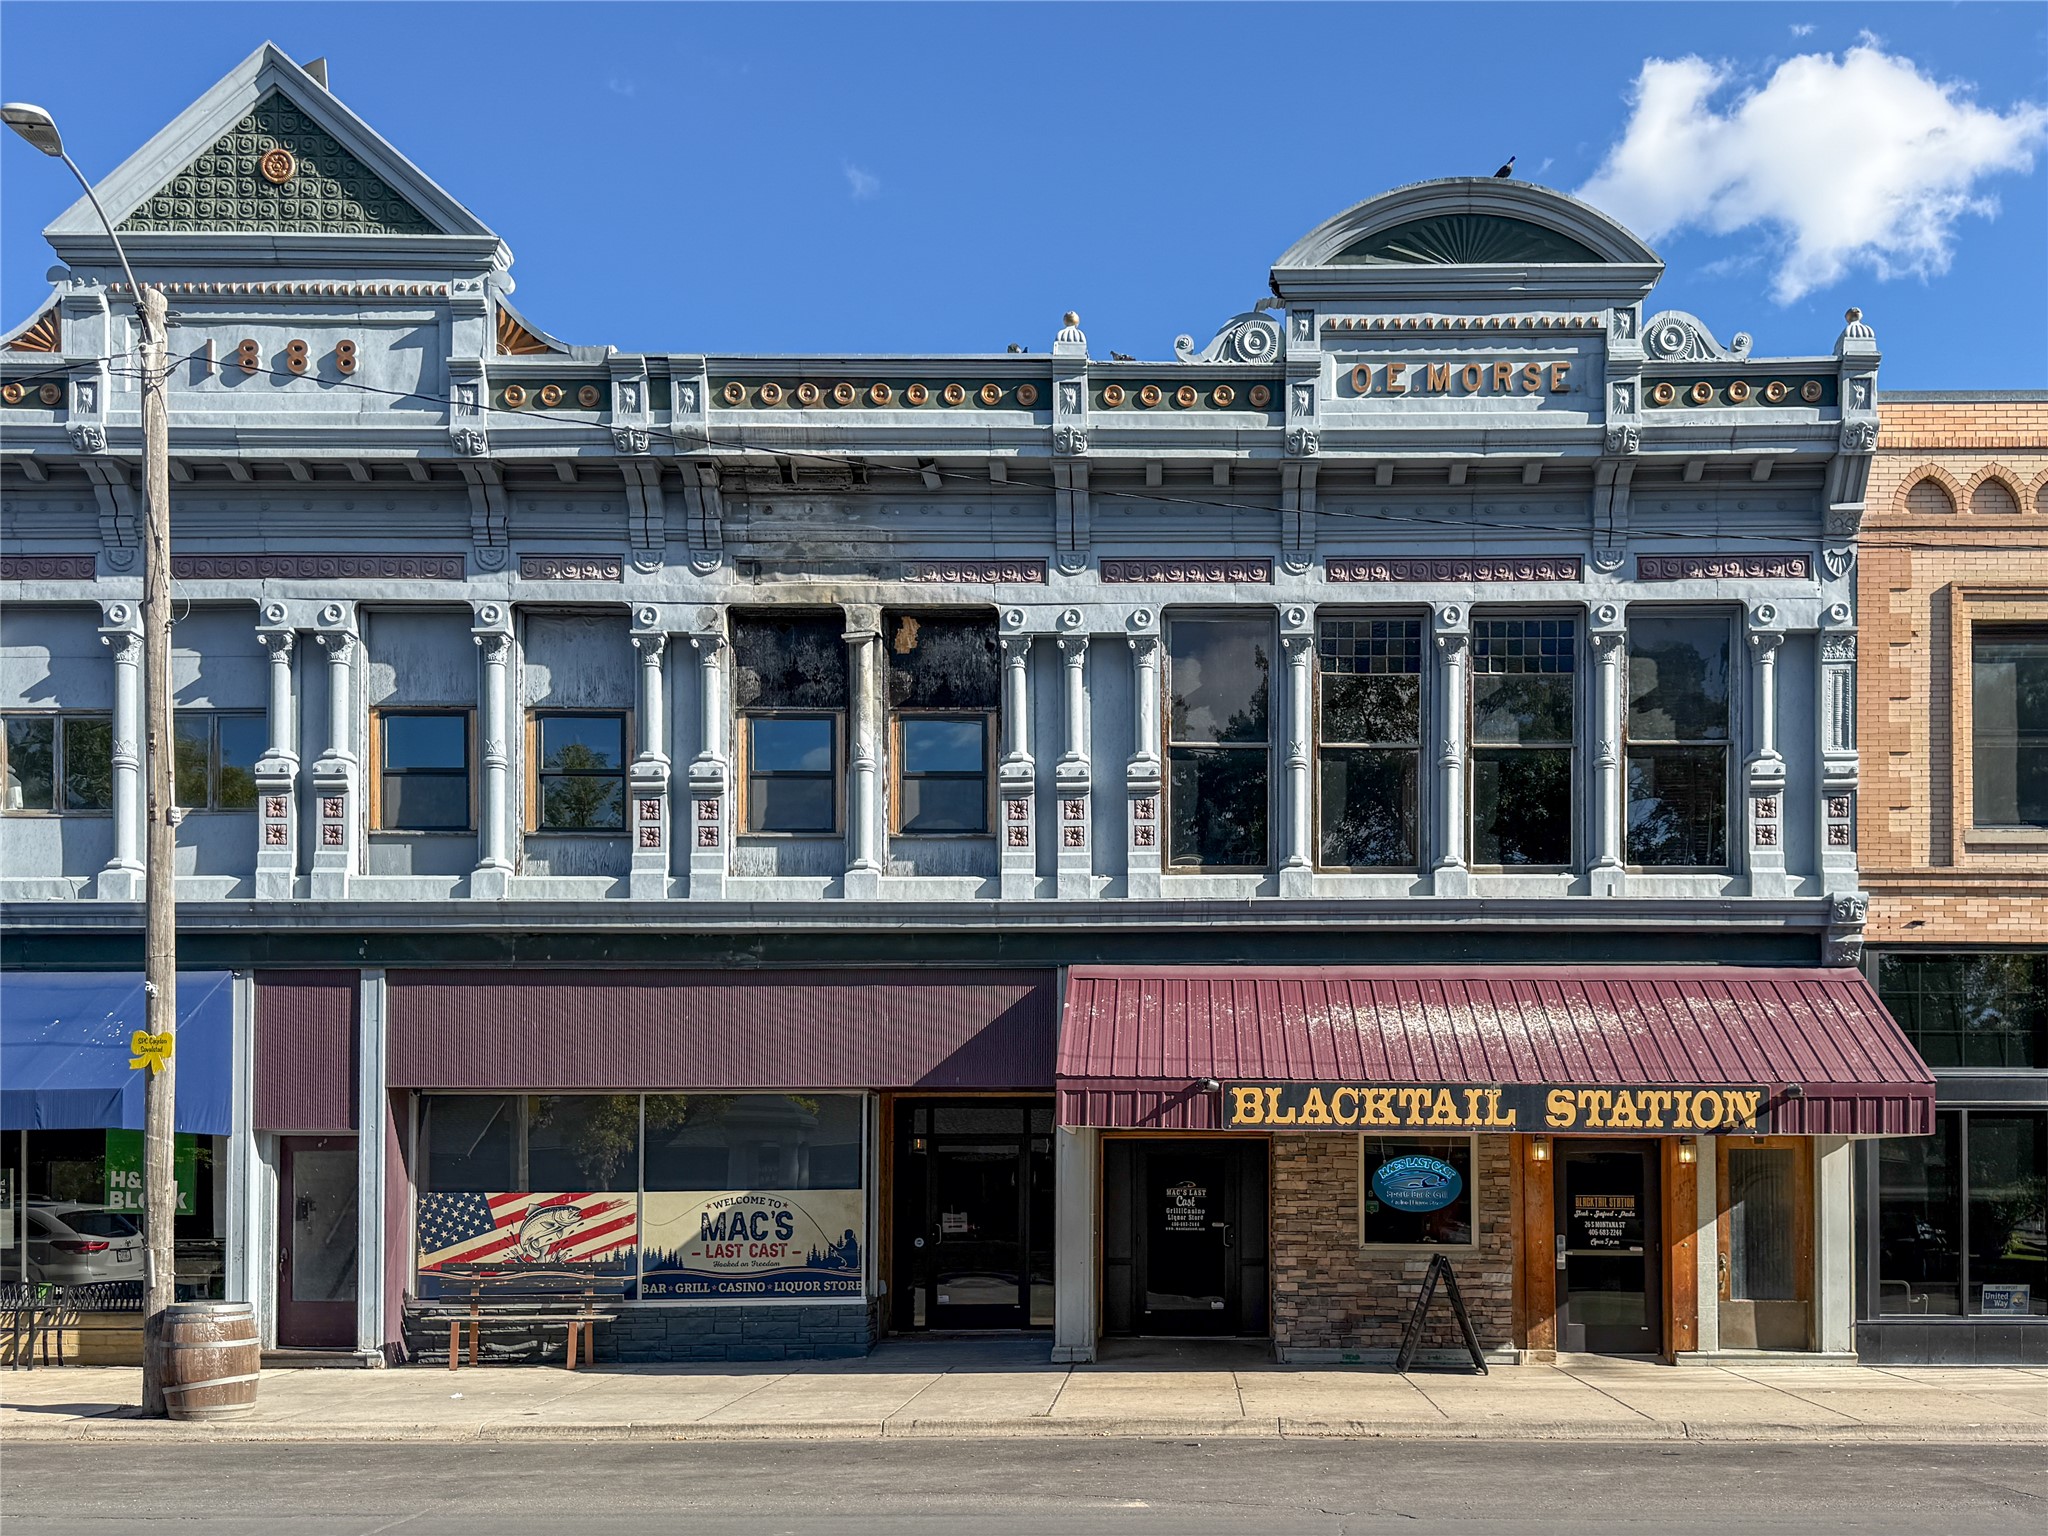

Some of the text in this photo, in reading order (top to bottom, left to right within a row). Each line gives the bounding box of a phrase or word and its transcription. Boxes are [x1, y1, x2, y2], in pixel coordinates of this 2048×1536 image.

[206, 338, 358, 375] 1888
[1230, 1086, 1759, 1129] BLACKTAIL STATION
[1406, 1157, 1432, 1169] LAST
[1431, 1160, 1456, 1180] CAST
[110, 1170, 142, 1189] H&
[1166, 1188, 1187, 1196] MAC'S
[109, 1190, 187, 1210] BLK
[712, 1195, 782, 1210] WELCOME TO
[1176, 1195, 1195, 1207] Cast
[1575, 1197, 1635, 1208] BLACKTAIL STATION
[701, 1210, 794, 1242] MAC'S
[705, 1242, 788, 1259] LAST CAST
[713, 1260, 740, 1268] Hooked
[751, 1260, 781, 1268] Freedom
[642, 1280, 862, 1294] BAR GRILL CASINO LIQUOR STORE
[1985, 1292, 2009, 1300] United
[1994, 1299, 2009, 1308] Way
